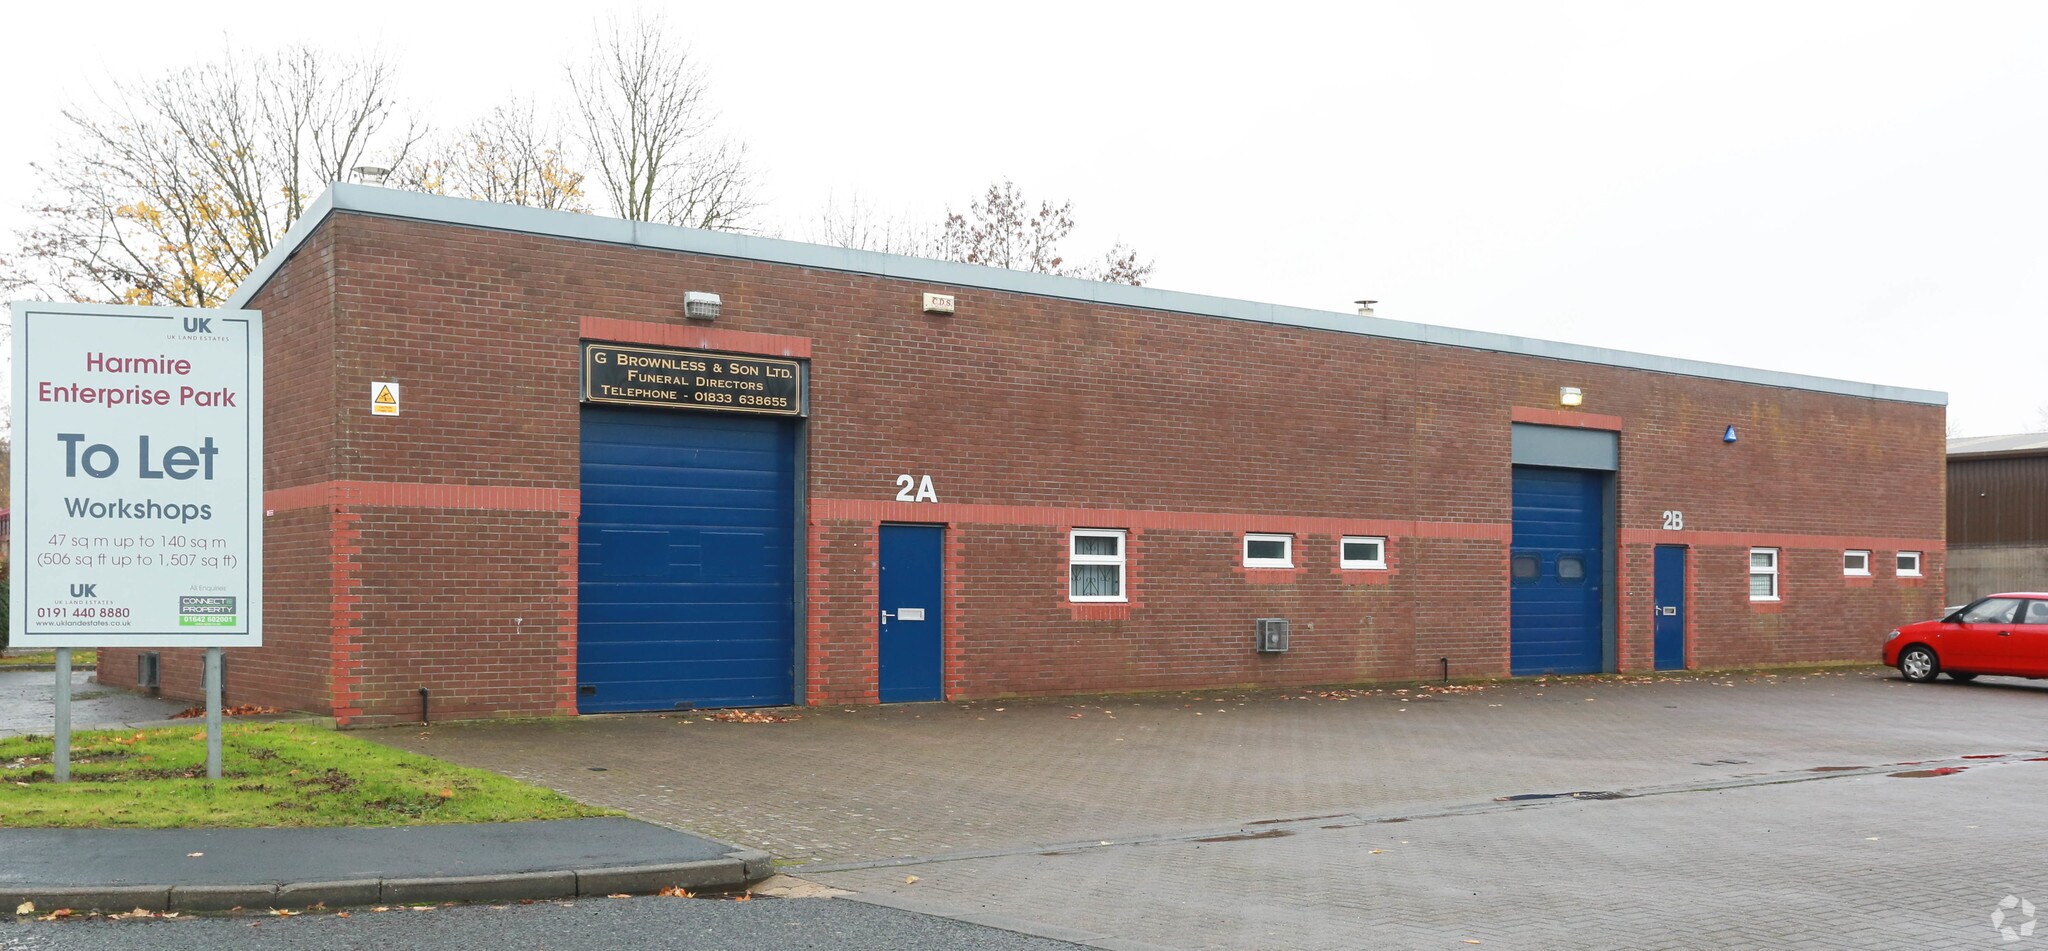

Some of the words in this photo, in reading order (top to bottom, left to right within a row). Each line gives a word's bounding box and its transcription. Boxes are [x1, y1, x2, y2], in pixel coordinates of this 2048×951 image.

[183, 317, 212, 333] UK
[87, 352, 191, 375] Harmire
[595, 352, 607, 364] G
[713, 364, 722, 373] &
[39, 382, 171, 408] Enterprise
[180, 386, 237, 407] Park
[694, 392, 733, 404] 01833
[739, 395, 788, 407] 638655
[57, 433, 120, 478] To
[139, 435, 219, 480] Let
[896, 474, 938, 502] 2A
[64, 497, 212, 524] Workshops
[1662, 510, 1684, 531] 2B
[48, 534, 66, 547] 47
[71, 537, 89, 549] sq
[94, 537, 109, 547] m
[114, 537, 134, 550] up
[139, 535, 155, 548] to
[161, 535, 186, 549] 140
[190, 538, 207, 551] sq
[212, 538, 227, 548] m
[36, 552, 71, 568] (506
[75, 555, 93, 567] sq
[98, 553, 108, 566] ft
[111, 555, 132, 568] up
[137, 554, 153, 567] to
[159, 554, 196, 568] 1,507
[201, 556, 218, 569] sq
[223, 554, 238, 569] ft)
[70, 583, 97, 598] UK
[182, 597, 226, 605] CONNECT
[37, 607, 67, 618] 0191
[72, 607, 96, 618] 440
[99, 607, 131, 619] 8880
